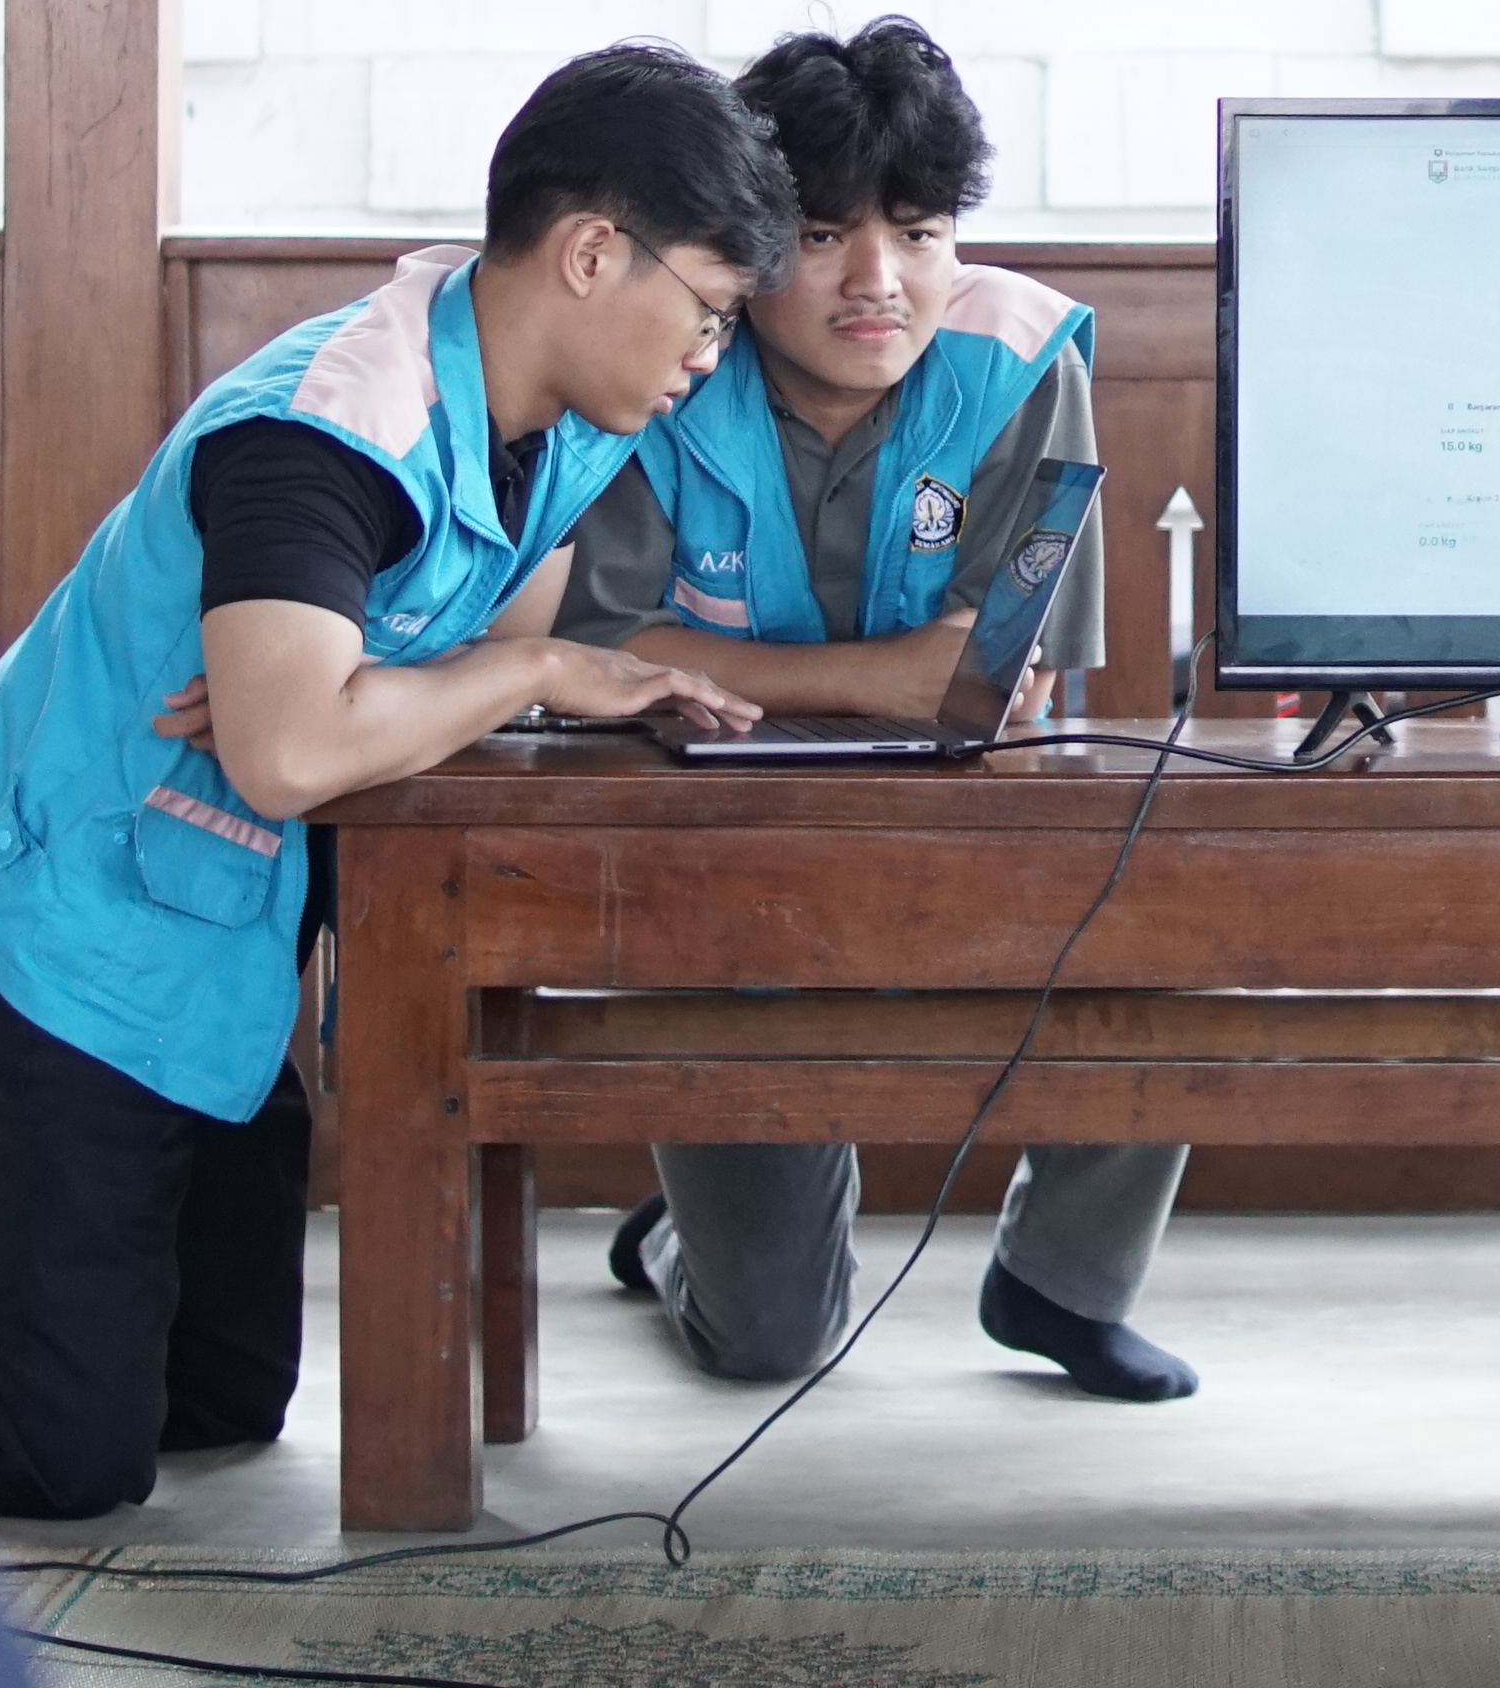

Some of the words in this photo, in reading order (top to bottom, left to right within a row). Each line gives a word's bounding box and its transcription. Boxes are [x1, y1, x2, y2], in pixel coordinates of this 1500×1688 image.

[1440, 440, 1466, 452] 15.0
[1468, 440, 1483, 454] kg
[1418, 536, 1438, 548] 0.0
[1440, 536, 1457, 549] kg
